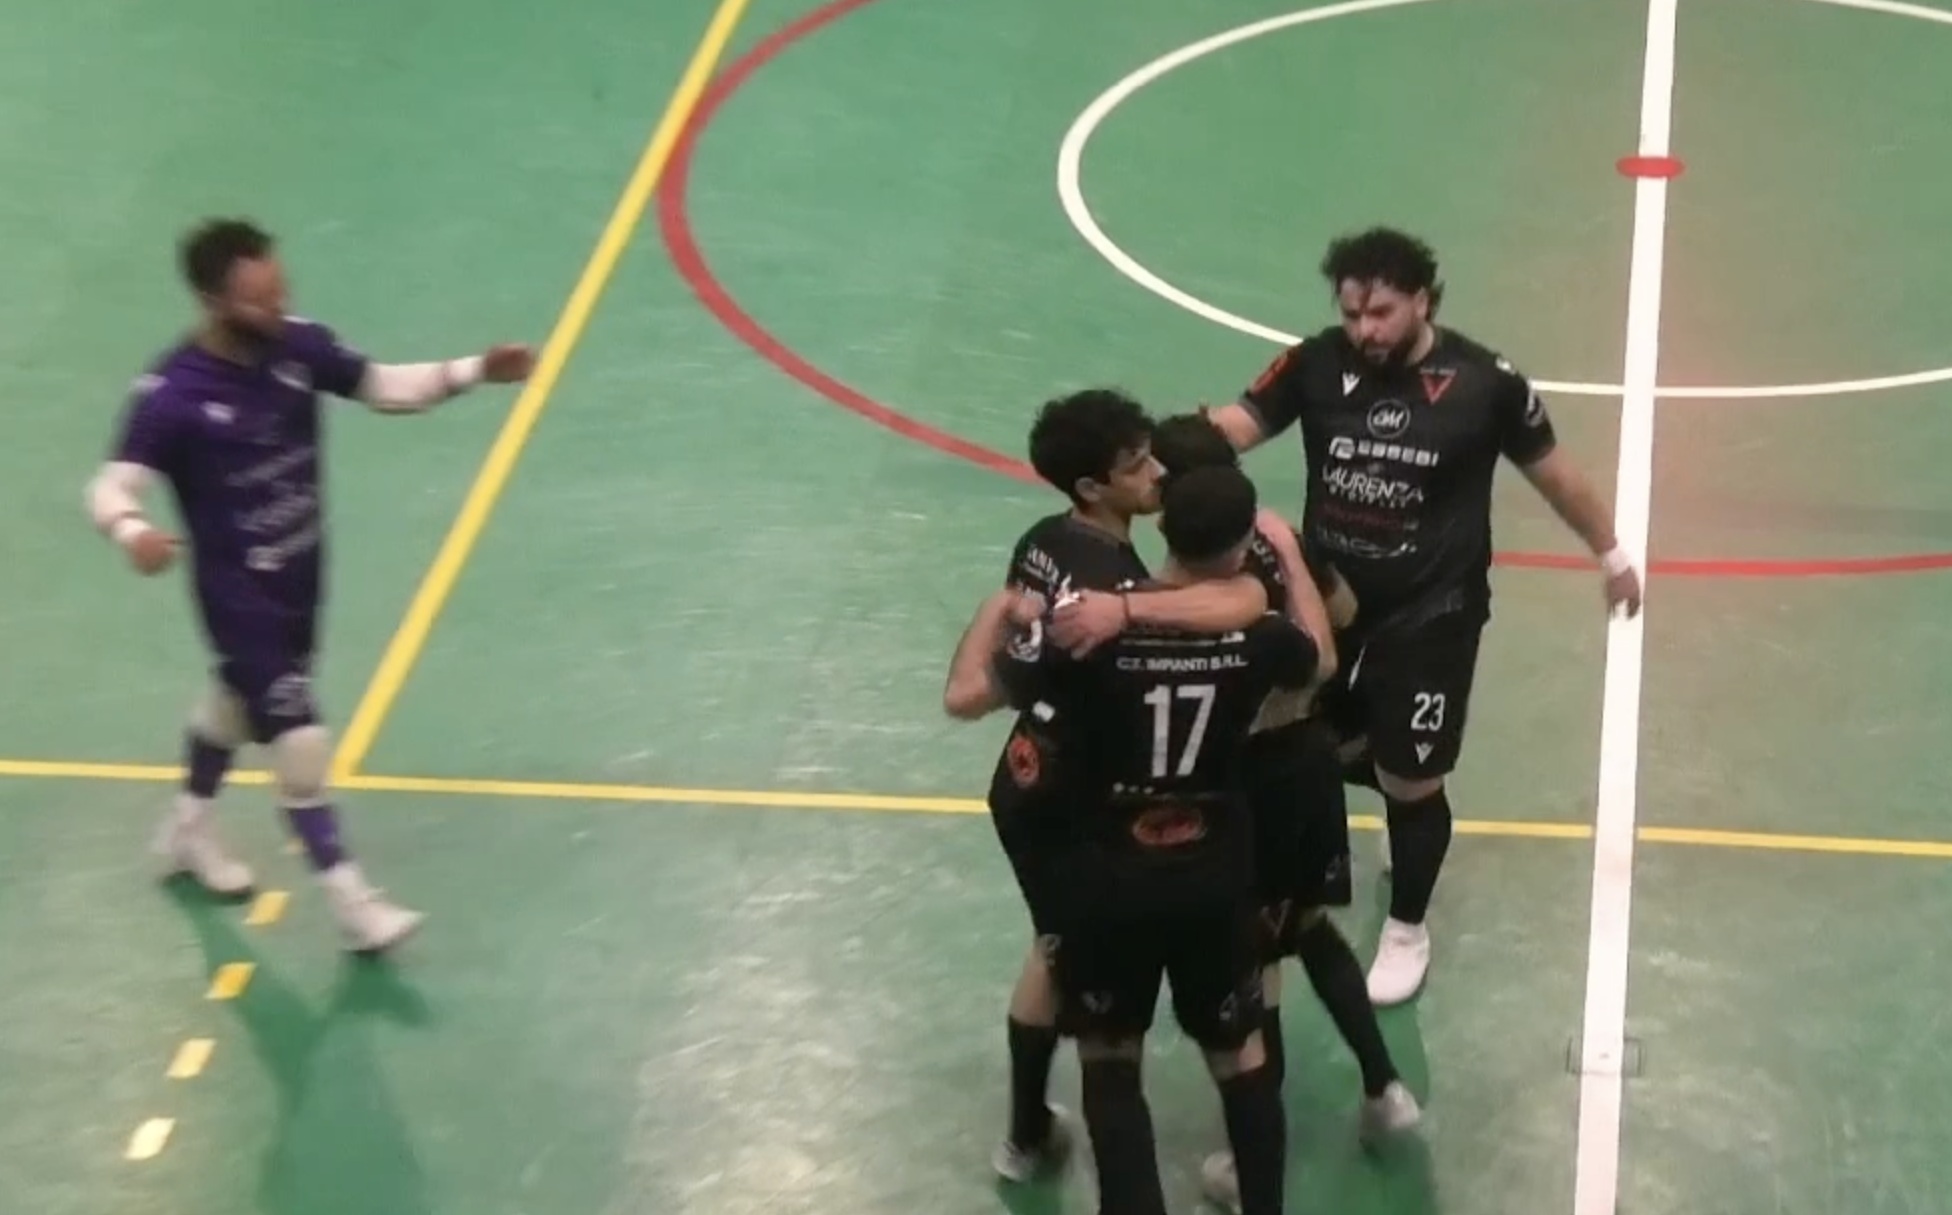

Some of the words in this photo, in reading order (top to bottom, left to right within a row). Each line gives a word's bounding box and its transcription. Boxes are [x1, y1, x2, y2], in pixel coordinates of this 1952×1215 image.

[1322, 463, 1425, 503] LAURENZA
[1146, 657, 1208, 671] IMPIANTI
[1144, 684, 1216, 778] 17
[1410, 691, 1446, 731] 23
